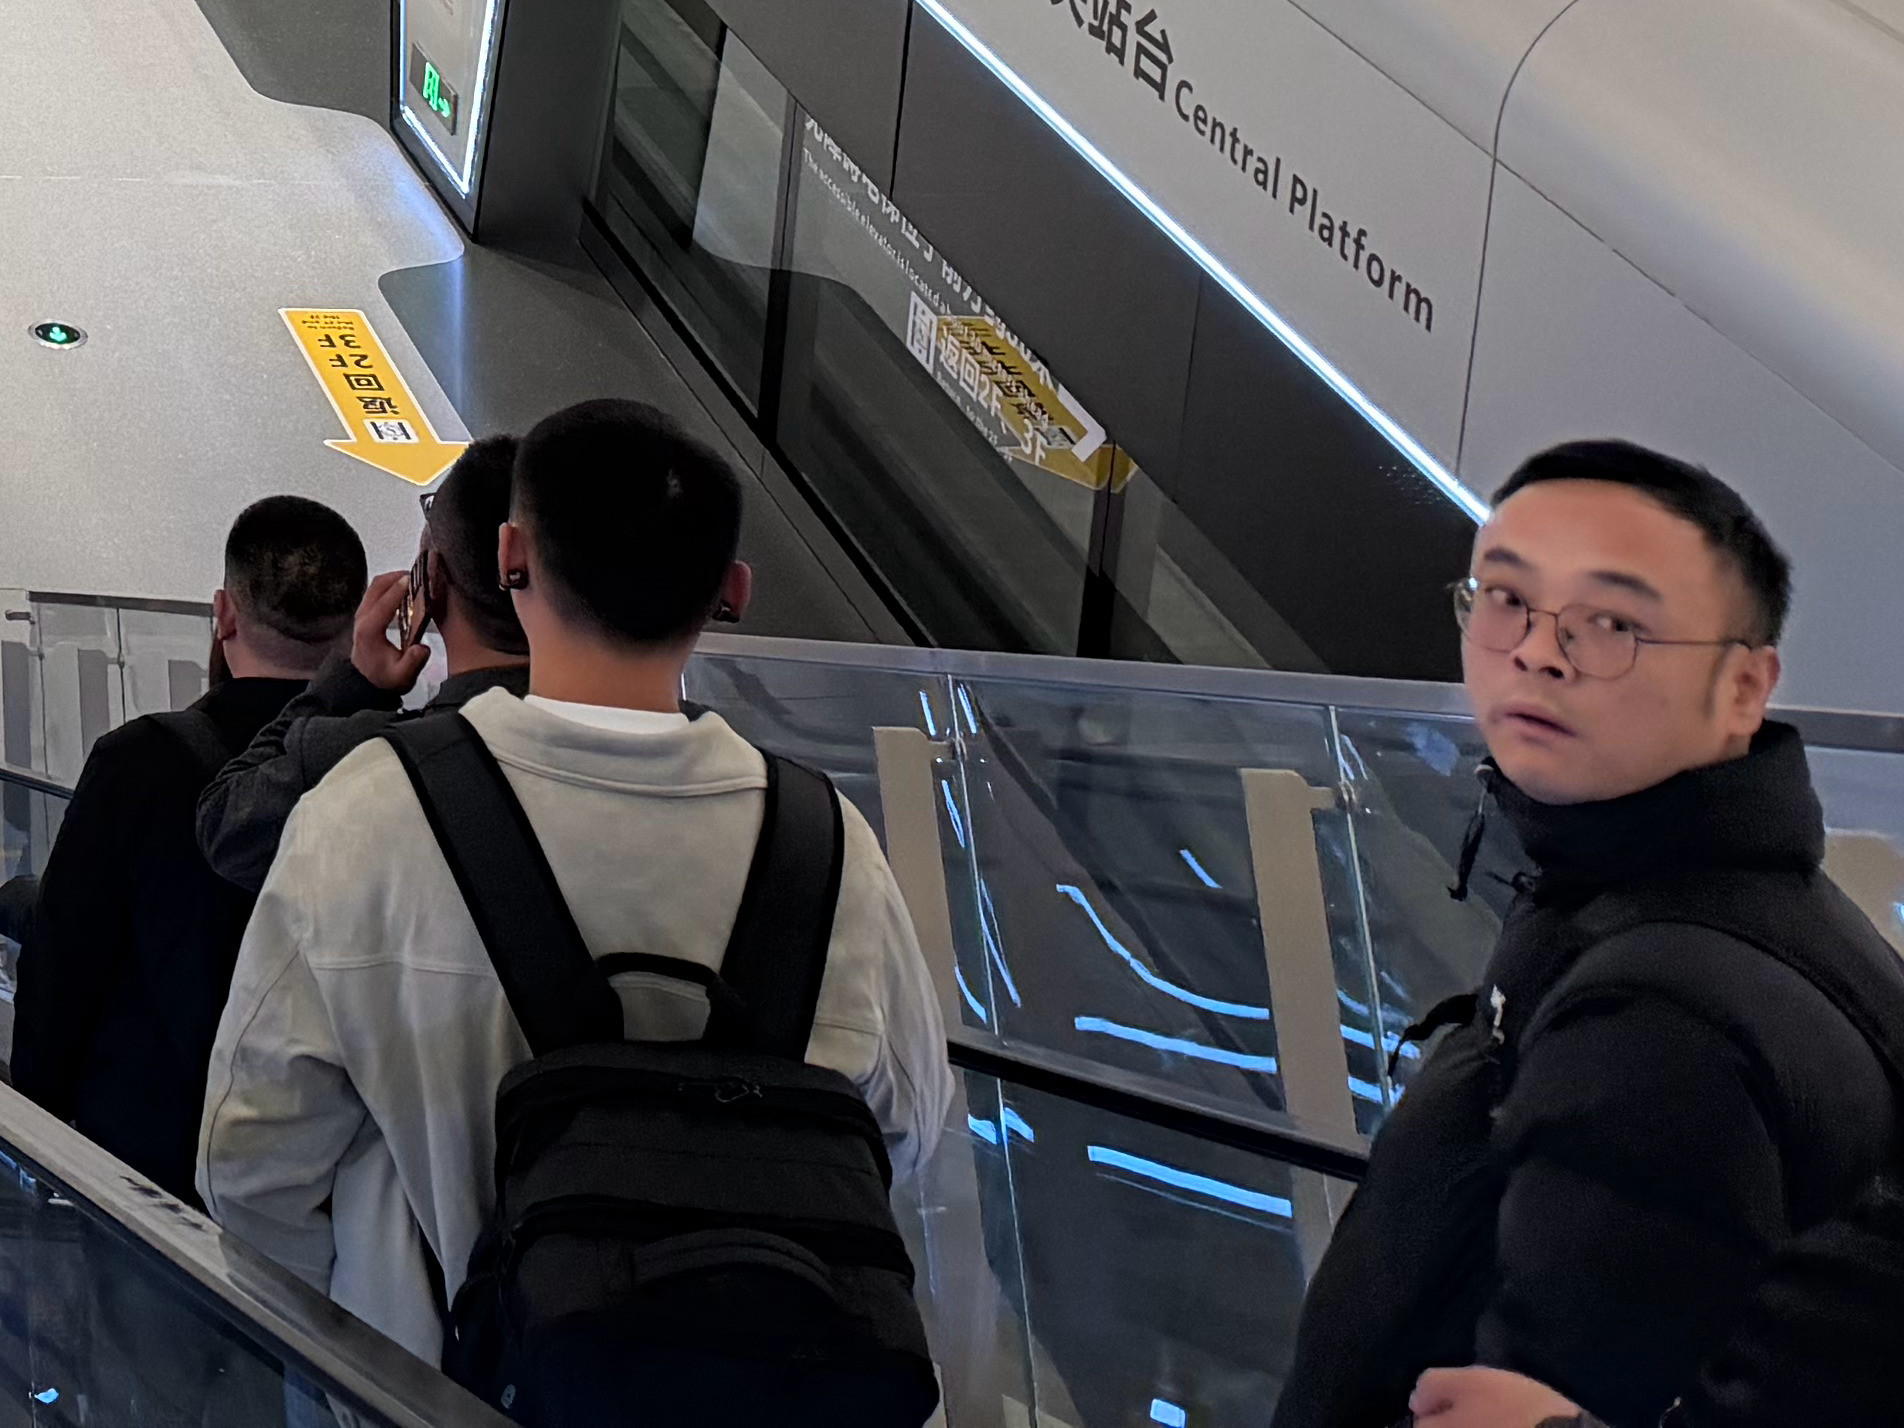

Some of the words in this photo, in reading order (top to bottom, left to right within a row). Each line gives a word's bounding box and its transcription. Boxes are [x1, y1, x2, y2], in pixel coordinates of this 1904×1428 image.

[1173, 78, 1281, 202] Central
[1290, 172, 1435, 333] Platform
[317, 333, 361, 349] 3F
[328, 353, 373, 369] 2F
